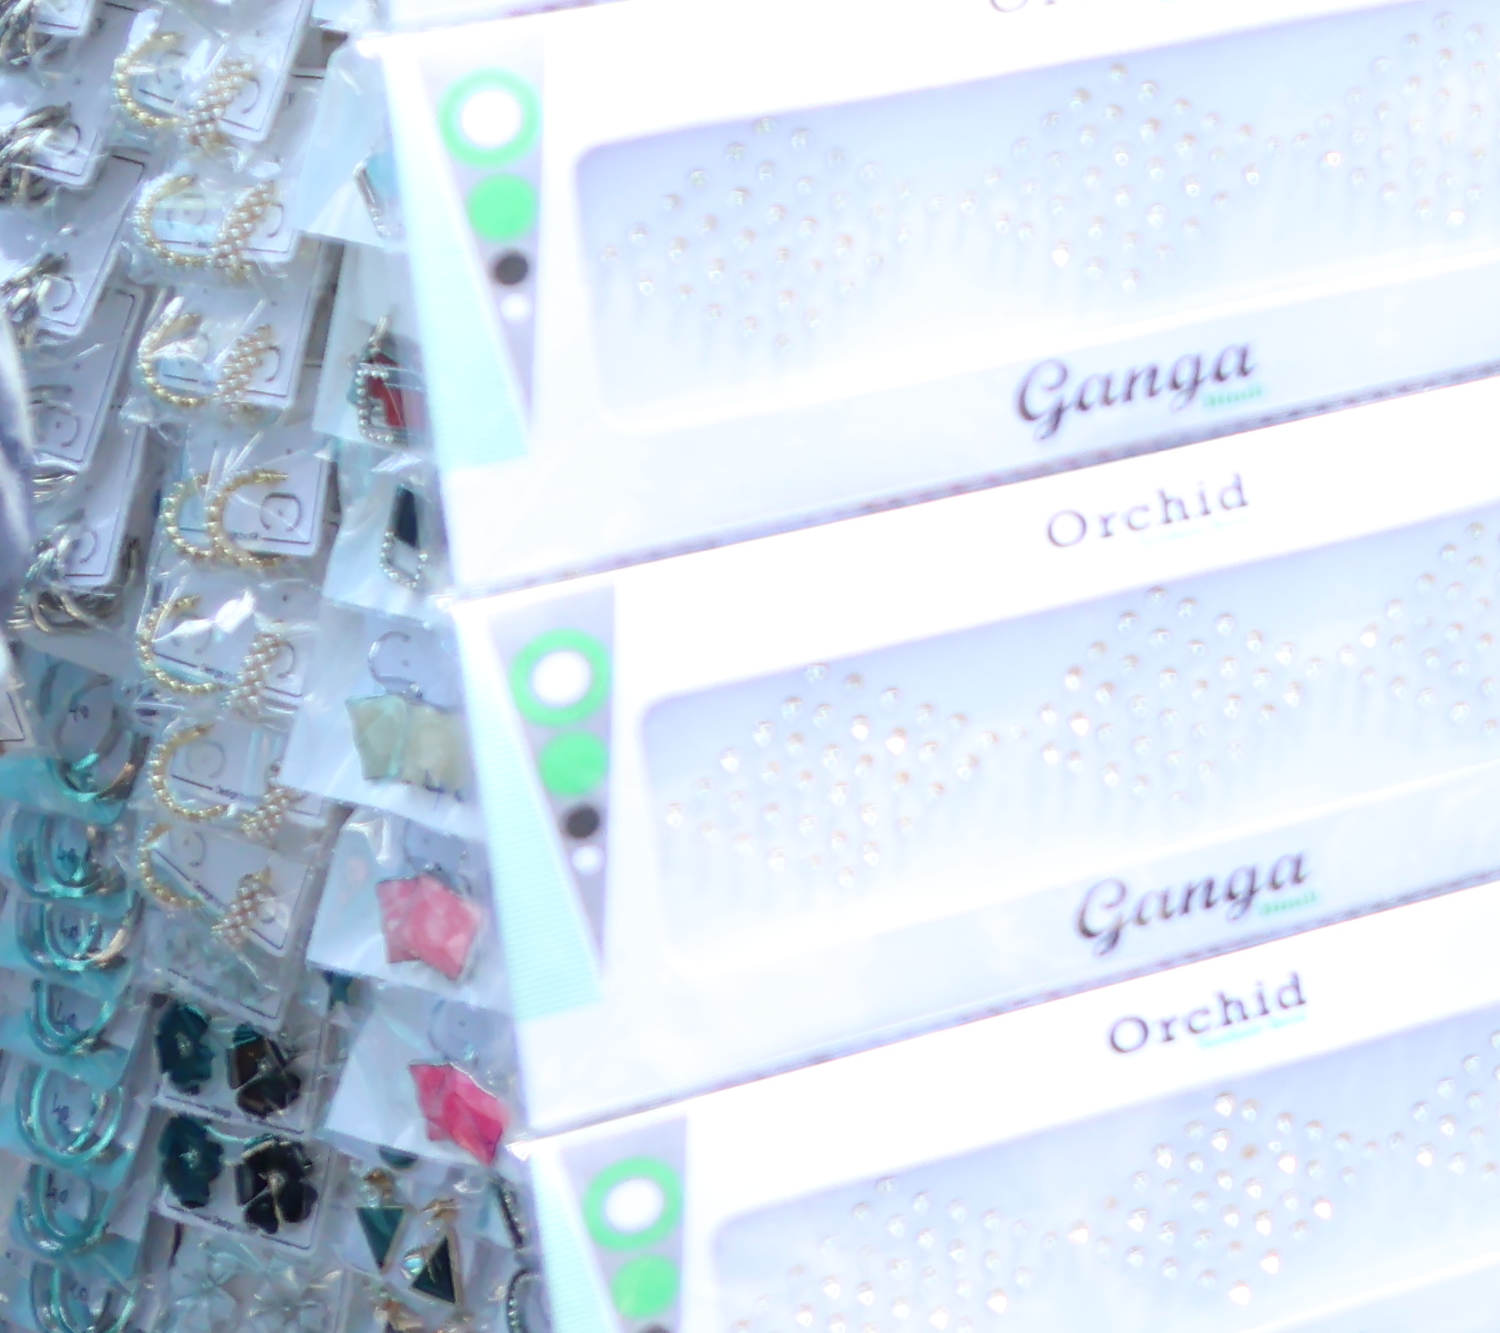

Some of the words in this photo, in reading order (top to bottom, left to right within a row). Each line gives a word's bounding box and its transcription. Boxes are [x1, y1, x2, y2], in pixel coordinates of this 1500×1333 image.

[1014, 339, 1255, 443] Ganga
[1045, 472, 1251, 549] Orchid
[1075, 850, 1310, 959] Ganga
[1108, 970, 1307, 1056] Orchid
